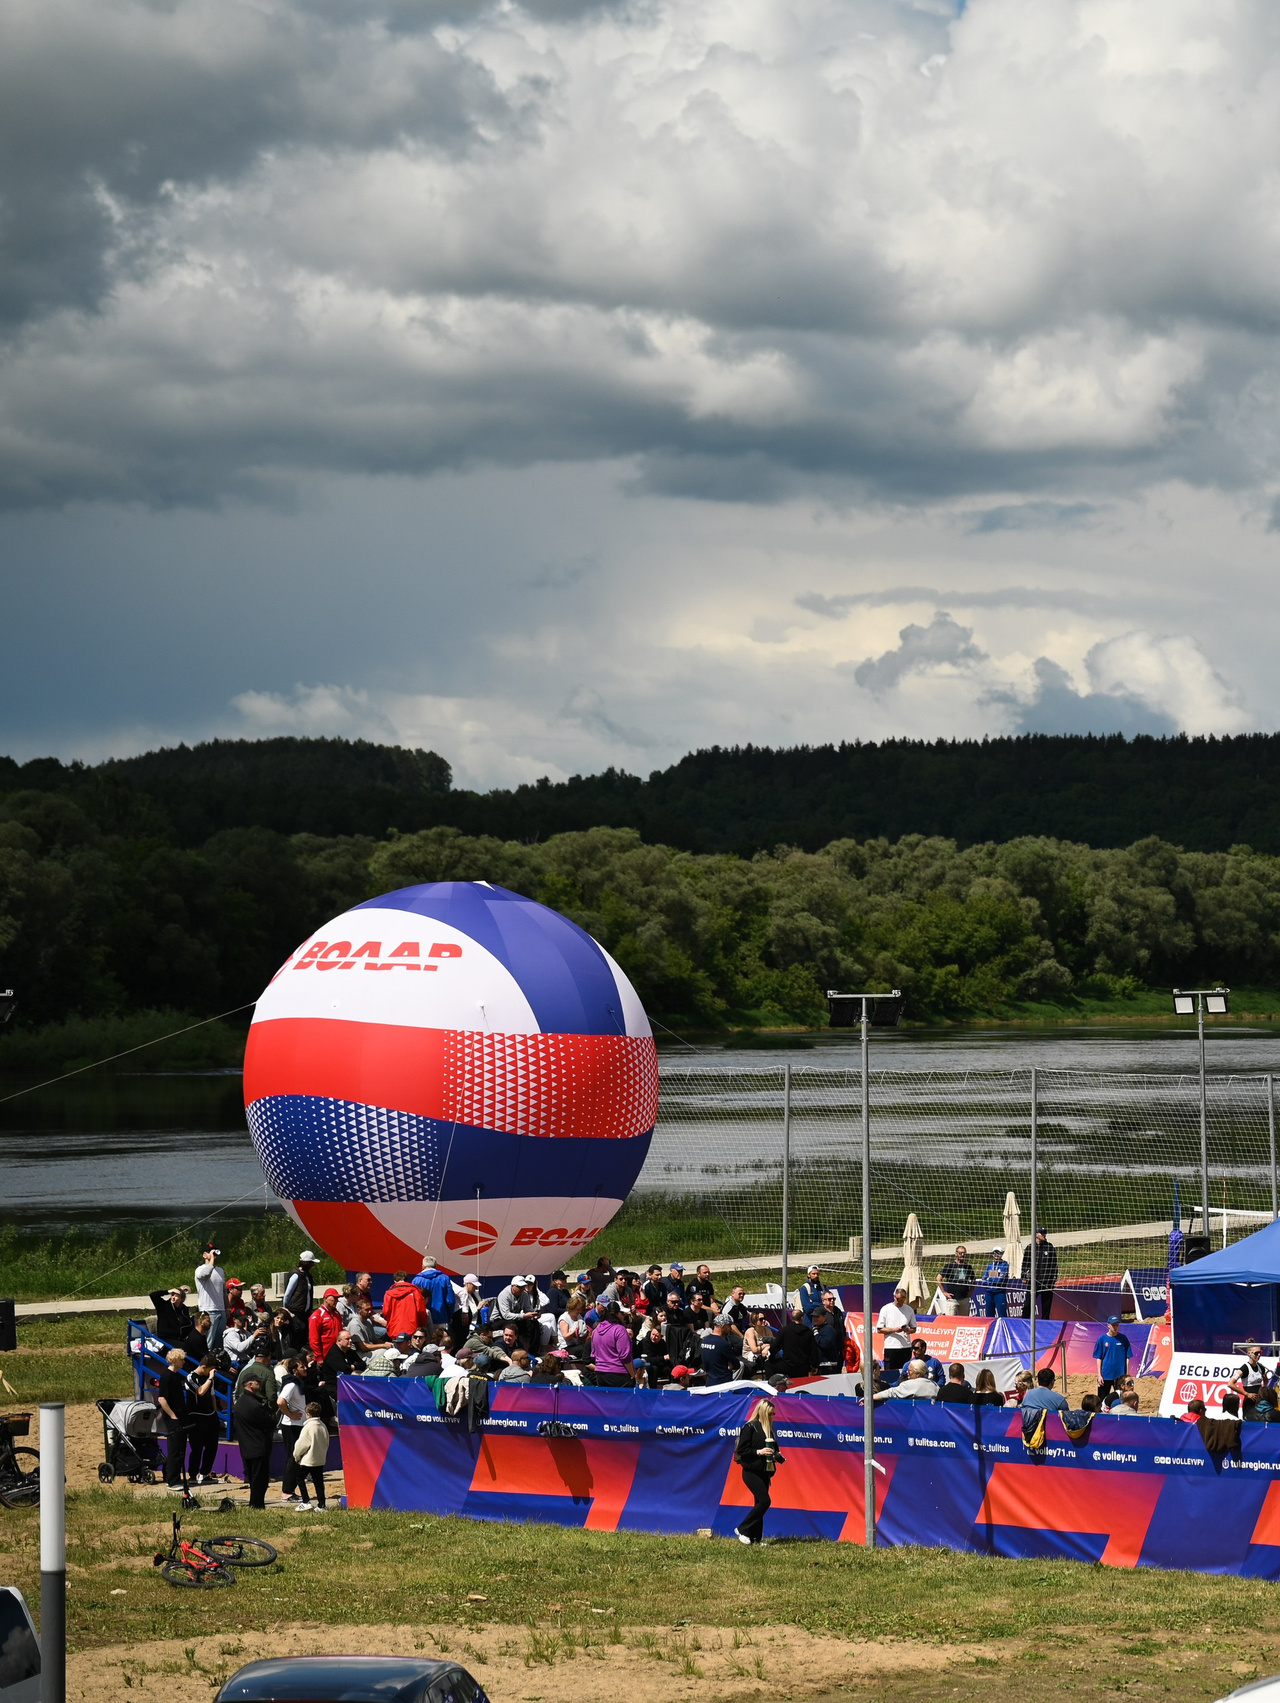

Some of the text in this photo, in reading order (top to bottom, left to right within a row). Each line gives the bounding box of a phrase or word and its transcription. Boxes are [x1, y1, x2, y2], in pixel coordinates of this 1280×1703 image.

[510, 1227, 605, 1247] ВОЛ
[922, 1327, 956, 1336] VOLLEYVFV
[1179, 1364, 1210, 1377] ВЕСЬ
[1213, 1367, 1240, 1378] ВОЛ
[373, 1409, 403, 1420] volley.ru
[432, 1416, 461, 1424] VOLLEYVFV
[483, 1418, 528, 1428] tularegion.ru
[610, 1423, 639, 1433] vc_tulitsa
[663, 1425, 705, 1436] volley71.ru
[727, 1427, 741, 1437] voll
[793, 1430, 822, 1440] VOLLEYVFV
[845, 1433, 893, 1444] tularon.ru
[915, 1437, 956, 1448] tulitsa.com
[979, 1444, 1010, 1453] vc_tulitsa
[1035, 1447, 1077, 1458] volley71.ru
[1102, 1451, 1137, 1464] volley.ru
[1172, 1457, 1205, 1466] VOLLEYVFV
